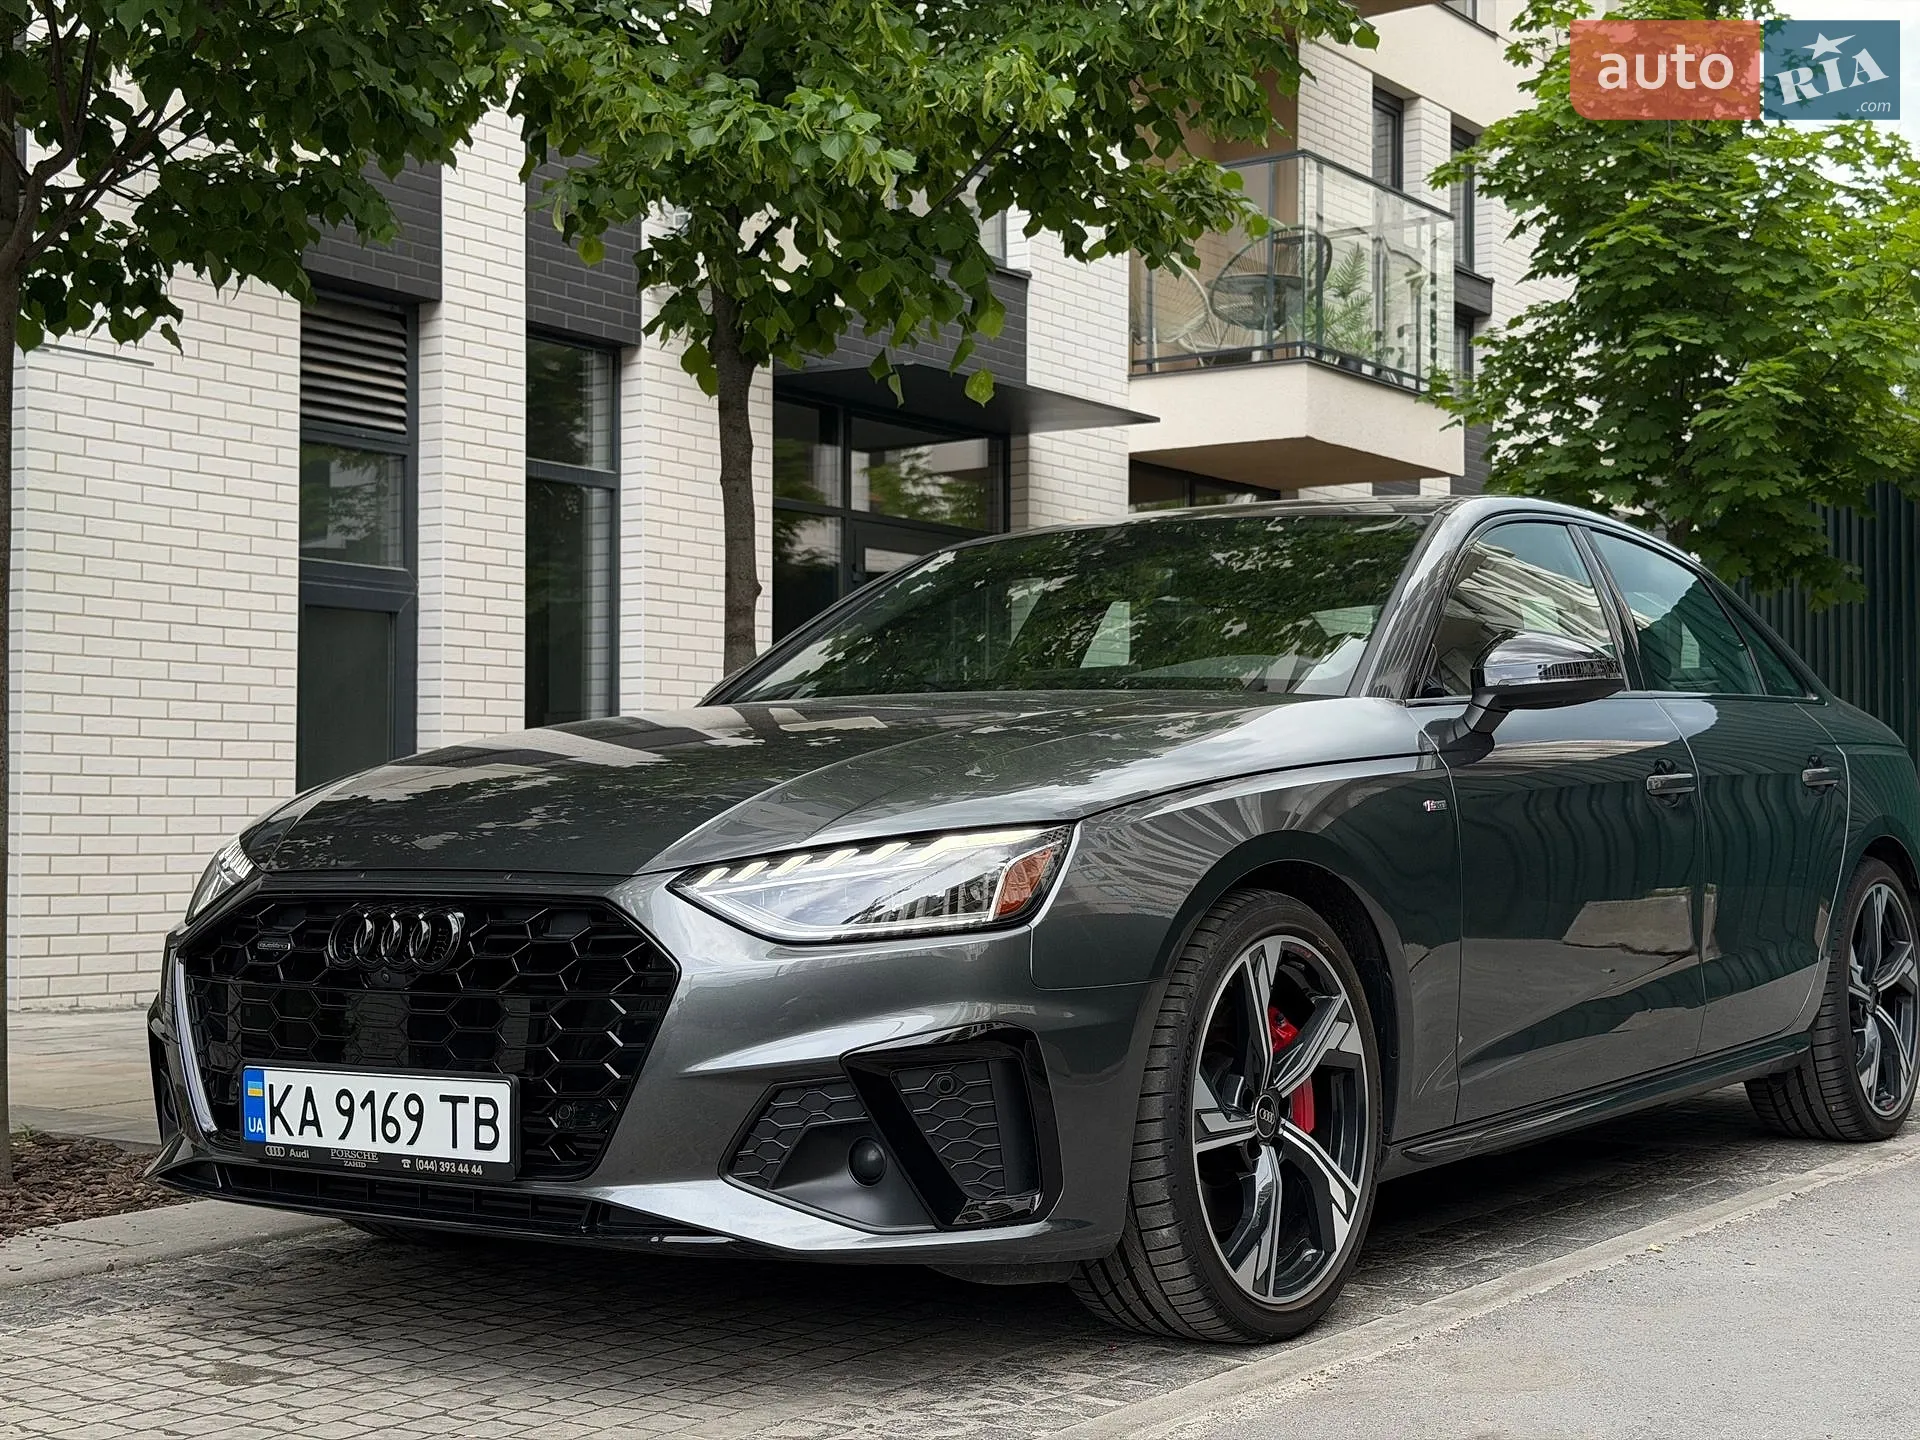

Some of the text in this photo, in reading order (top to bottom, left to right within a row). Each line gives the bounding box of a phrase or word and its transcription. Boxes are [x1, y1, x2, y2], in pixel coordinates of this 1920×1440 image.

[248, 1117, 264, 1133] UA
[268, 1083, 500, 1151] KA 9169 TB
[289, 1148, 310, 1159] Audi
[330, 1148, 378, 1160] PORSCHE
[415, 1158, 483, 1175] (044) 393 44 44
